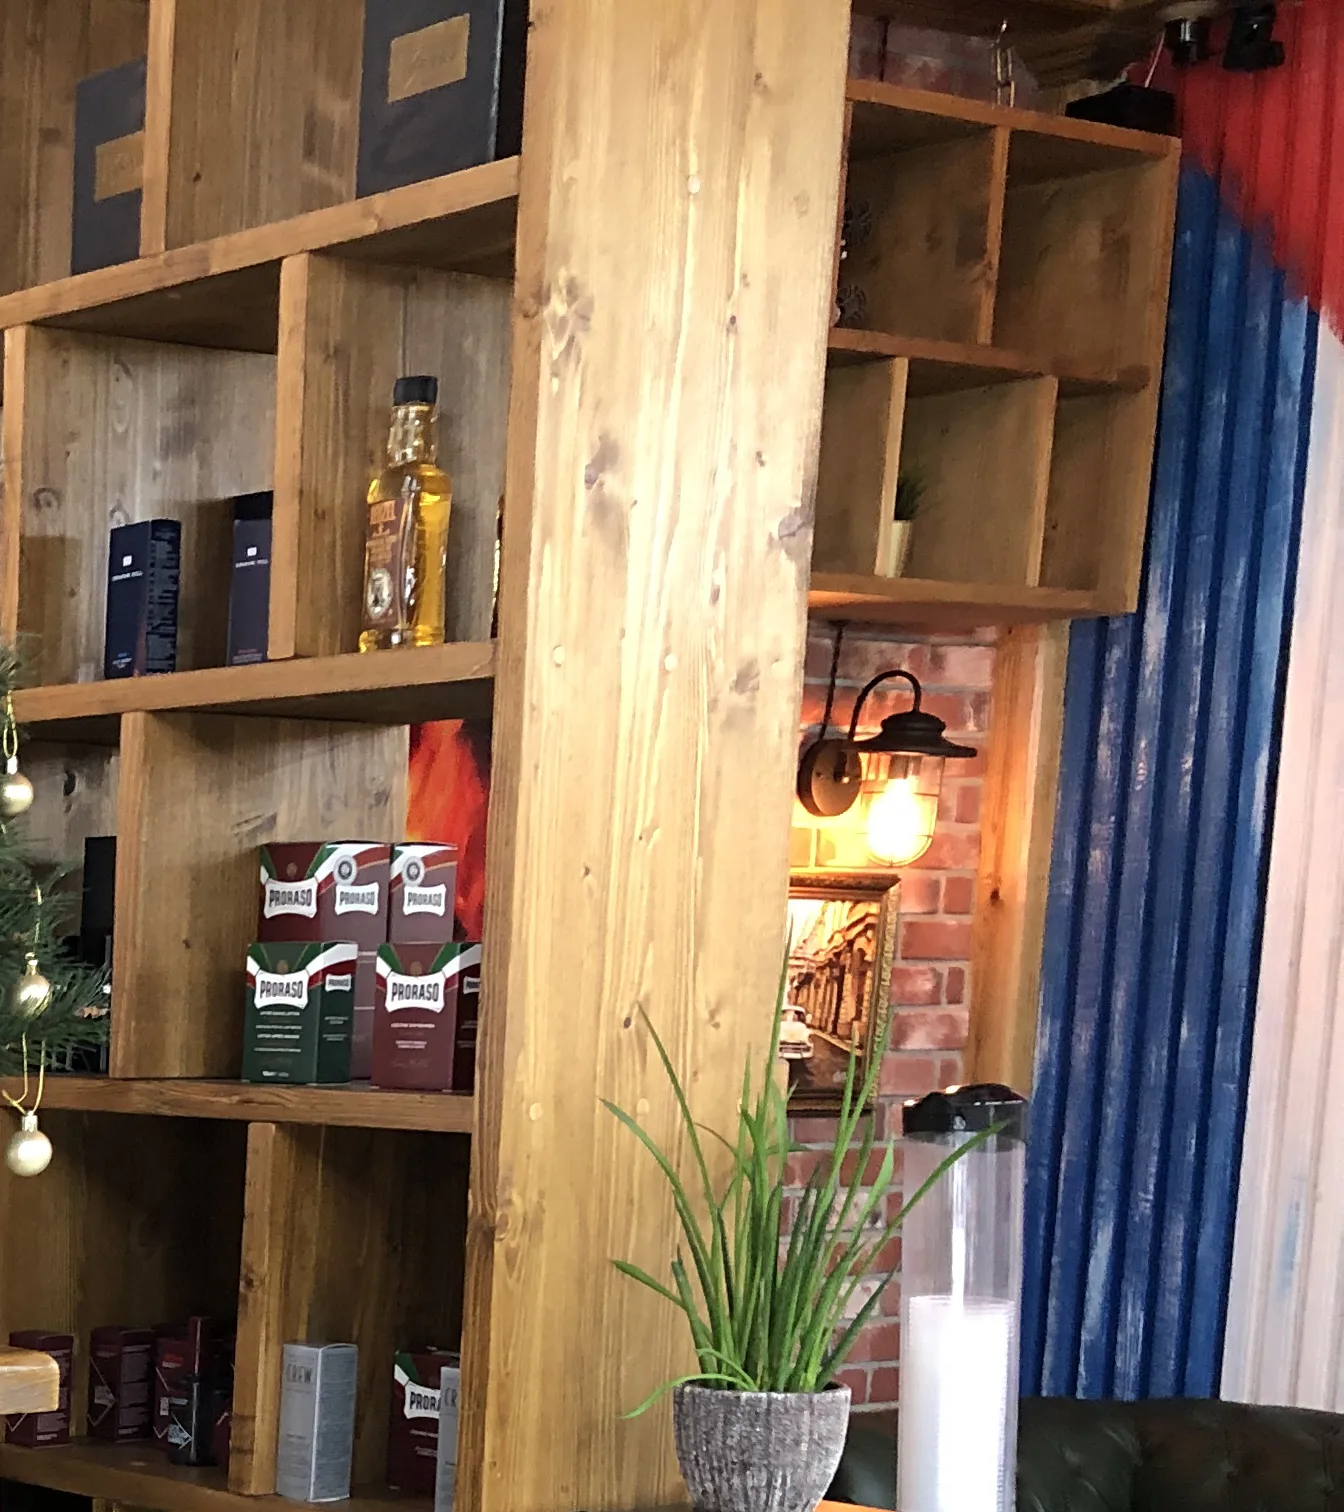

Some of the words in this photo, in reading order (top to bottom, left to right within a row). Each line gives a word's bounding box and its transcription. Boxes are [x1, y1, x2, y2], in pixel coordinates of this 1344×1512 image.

[269, 888, 313, 907] PRORASO
[259, 980, 303, 999] PRORASO
[391, 981, 440, 1002] PRORASO
